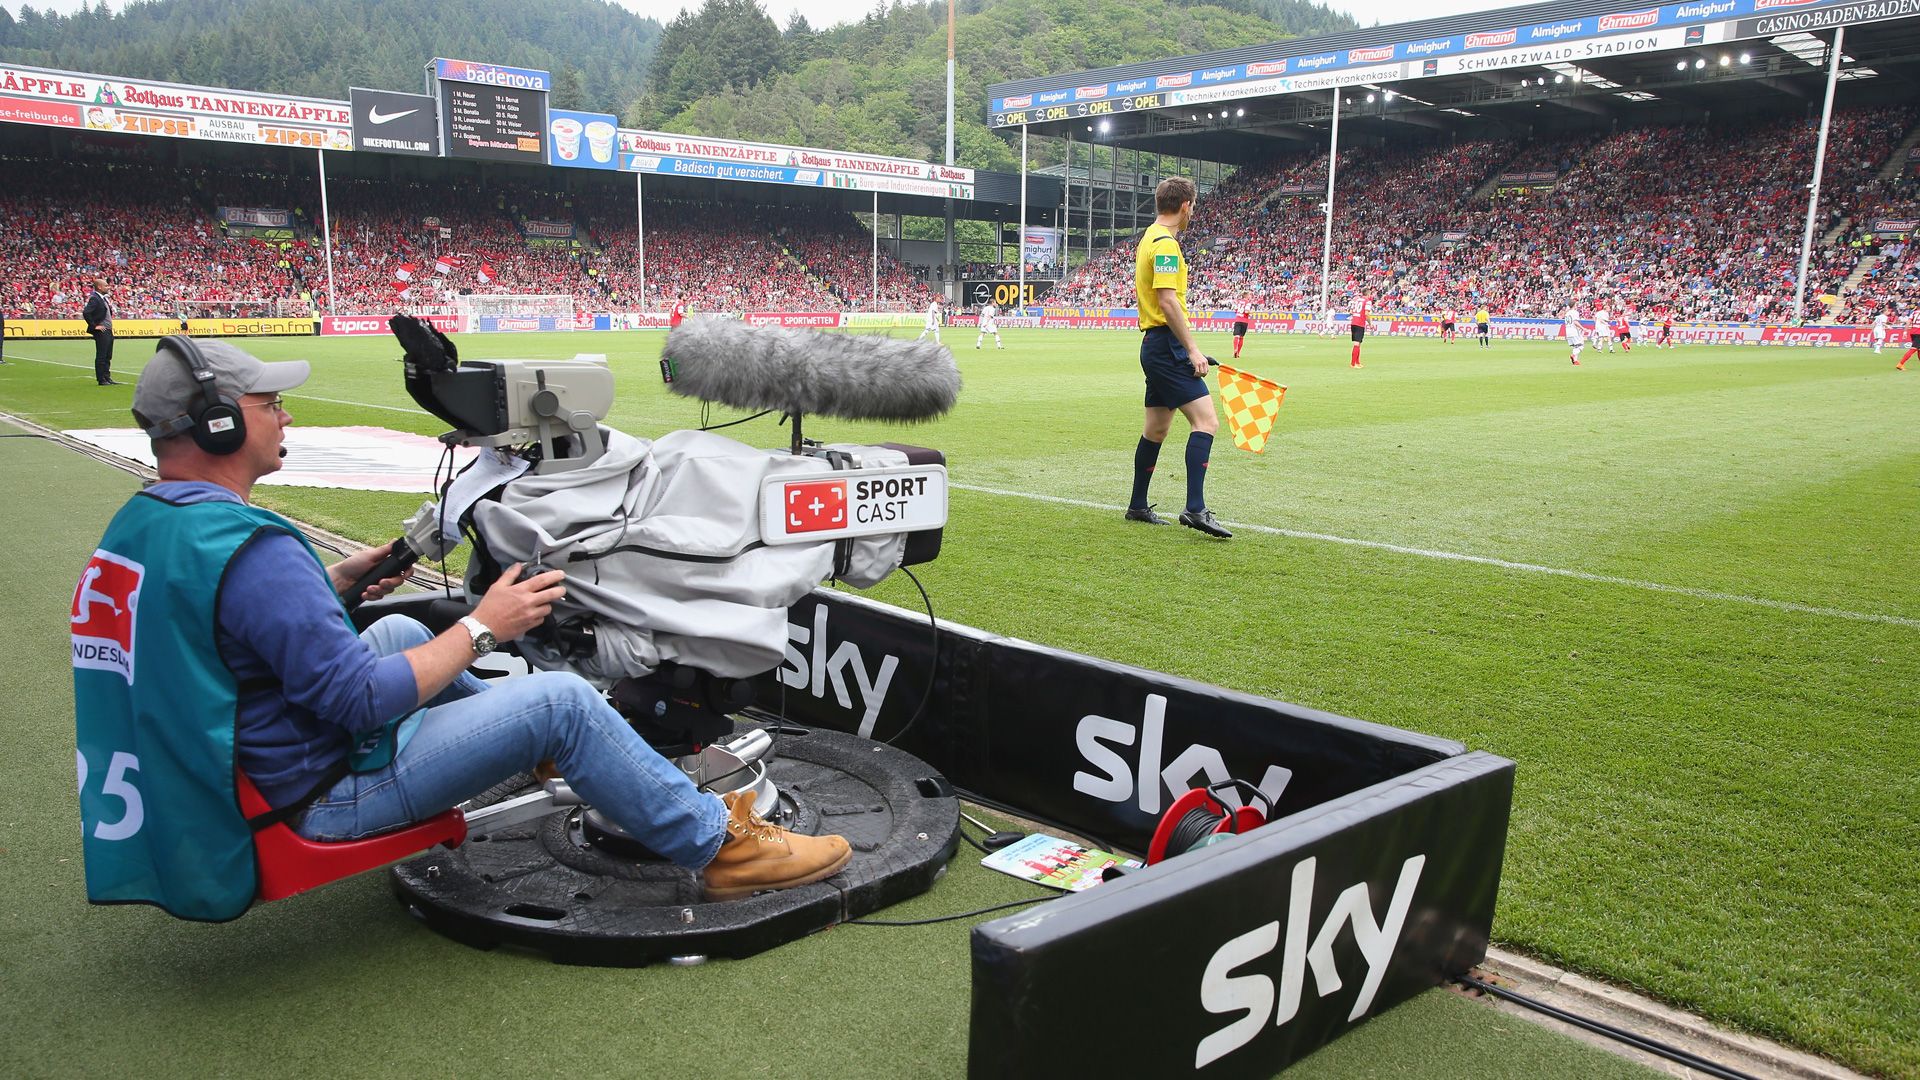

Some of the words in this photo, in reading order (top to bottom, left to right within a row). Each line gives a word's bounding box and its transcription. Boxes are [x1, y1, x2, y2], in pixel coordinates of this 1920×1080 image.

[1040, 92, 1067, 102] Almighurt
[1077, 87, 1106, 98] Ehrmann
[1116, 81, 1146, 92] Almighurt
[1158, 75, 1191, 87] Ehrmann
[1202, 69, 1235, 81] Almighurt
[1248, 62, 1285, 75] Ehrmann
[1298, 55, 1336, 69] Almighurt
[1350, 47, 1393, 62] Ehrmann
[1407, 40, 1450, 55] Almighurt
[1467, 32, 1515, 47] Ehrmann
[1532, 22, 1582, 38] Almighurt
[1601, 12, 1657, 30] Ehrmann
[1676, 0, 1735, 18] Almighurt
[0, 71, 86, 98] ÄPFLE
[466, 65, 543, 88] badenova
[1294, 78, 1334, 90] Techniker
[1336, 70, 1398, 84] Krankenkasse
[124, 85, 183, 108] Rothaus
[187, 96, 349, 123] TANNENZÄPFLE
[1186, 92, 1221, 102] Techniker
[1222, 85, 1277, 97] Krankenkasse
[1007, 113, 1027, 124] OPEL
[1047, 108, 1069, 119] OPEL
[1090, 102, 1113, 114] OPEL
[1135, 96, 1160, 108] OPEL
[124, 116, 189, 136] ZIPSE
[265, 129, 322, 146] ZIPSE
[209, 120, 244, 130] AUSBAU
[363, 137, 429, 151] NIKEFOOTBALL.COM
[635, 136, 671, 152] Rothaus
[676, 142, 776, 161] TANNENZÄPFLE
[674, 159, 714, 174] Badisch
[717, 164, 733, 177] gut
[735, 167, 784, 180] versichert.
[802, 153, 831, 166] Rothaus
[835, 158, 919, 175] TANNENZÄPFLE
[940, 167, 965, 180] Rothaus
[1876, 222, 1914, 230] Ehrman
[1025, 245, 1052, 254] mighurt
[995, 284, 1035, 306] OPEL
[638, 315, 668, 328] Rothau
[785, 316, 834, 325] SPORTWETTEN
[1084, 309, 1110, 317] PARK
[223, 321, 311, 334] baden.fm
[332, 318, 379, 333] tipico
[1398, 322, 1437, 333] tipico
[1458, 326, 1544, 336] SPOTWETTEN
[1648, 330, 1744, 340] PORTWETTEN
[1773, 329, 1832, 342] tipico
[856, 477, 927, 500] SPORT
[857, 501, 908, 523] CAST
[776, 604, 898, 738] sky
[1074, 694, 1292, 820] sky
[1195, 854, 1426, 1070] sky
